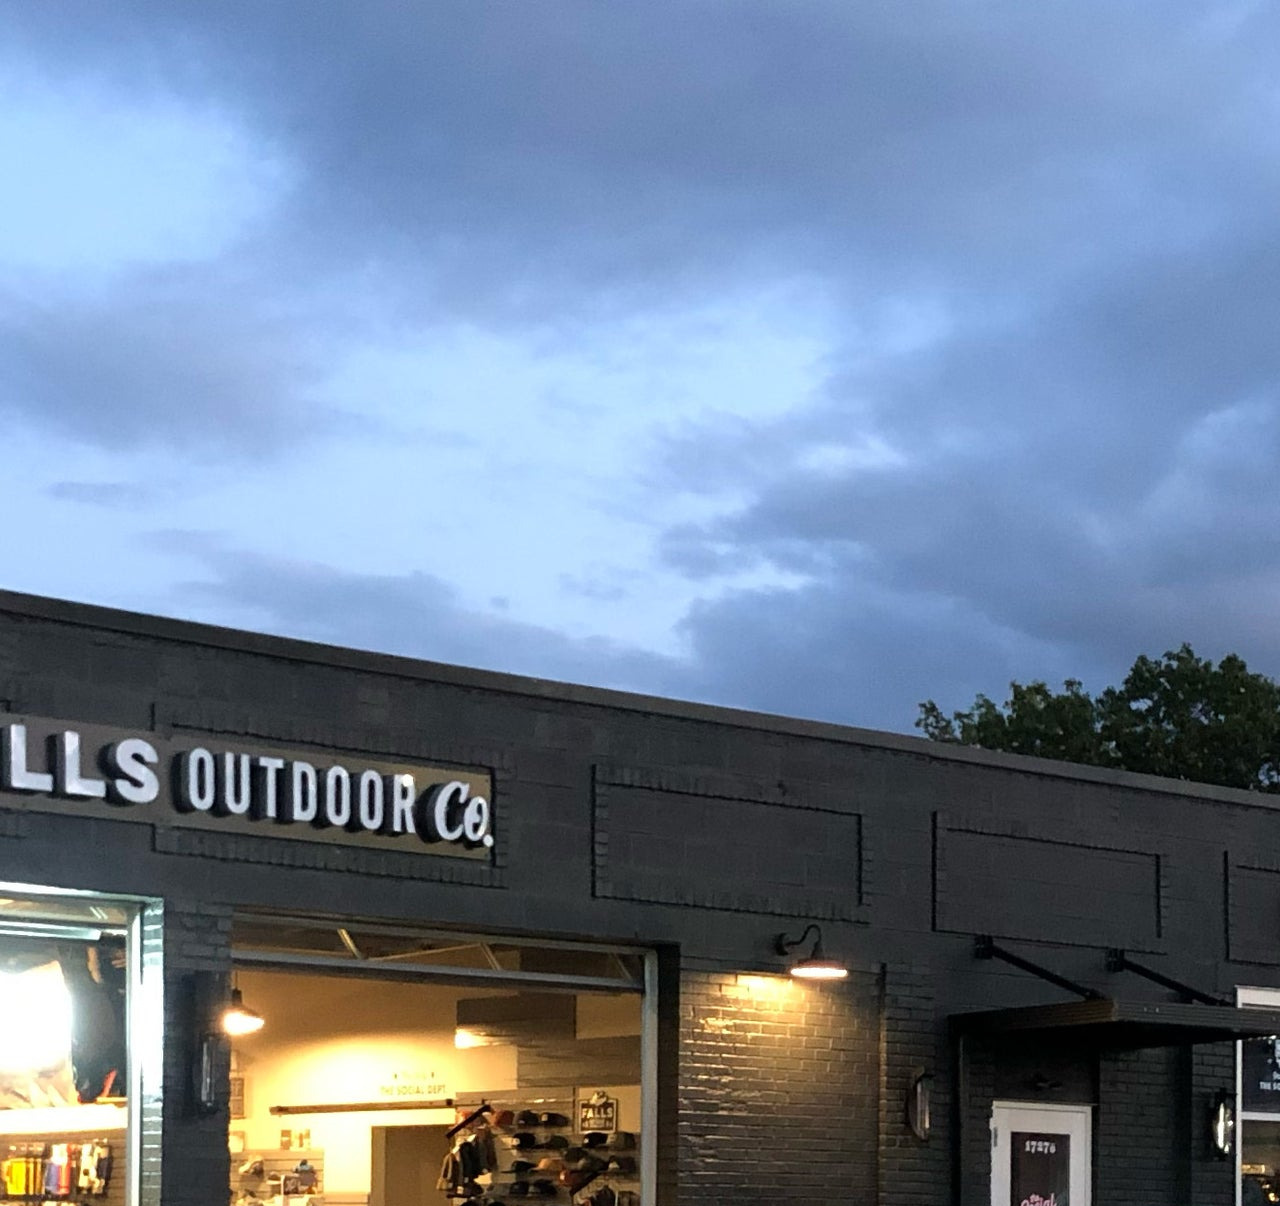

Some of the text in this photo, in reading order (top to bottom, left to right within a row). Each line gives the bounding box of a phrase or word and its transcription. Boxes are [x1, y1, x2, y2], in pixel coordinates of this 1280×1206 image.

[184, 747, 417, 835] OUTDOOR
[434, 780, 494, 848] Co.
[581, 1107, 614, 1119] FALLS
